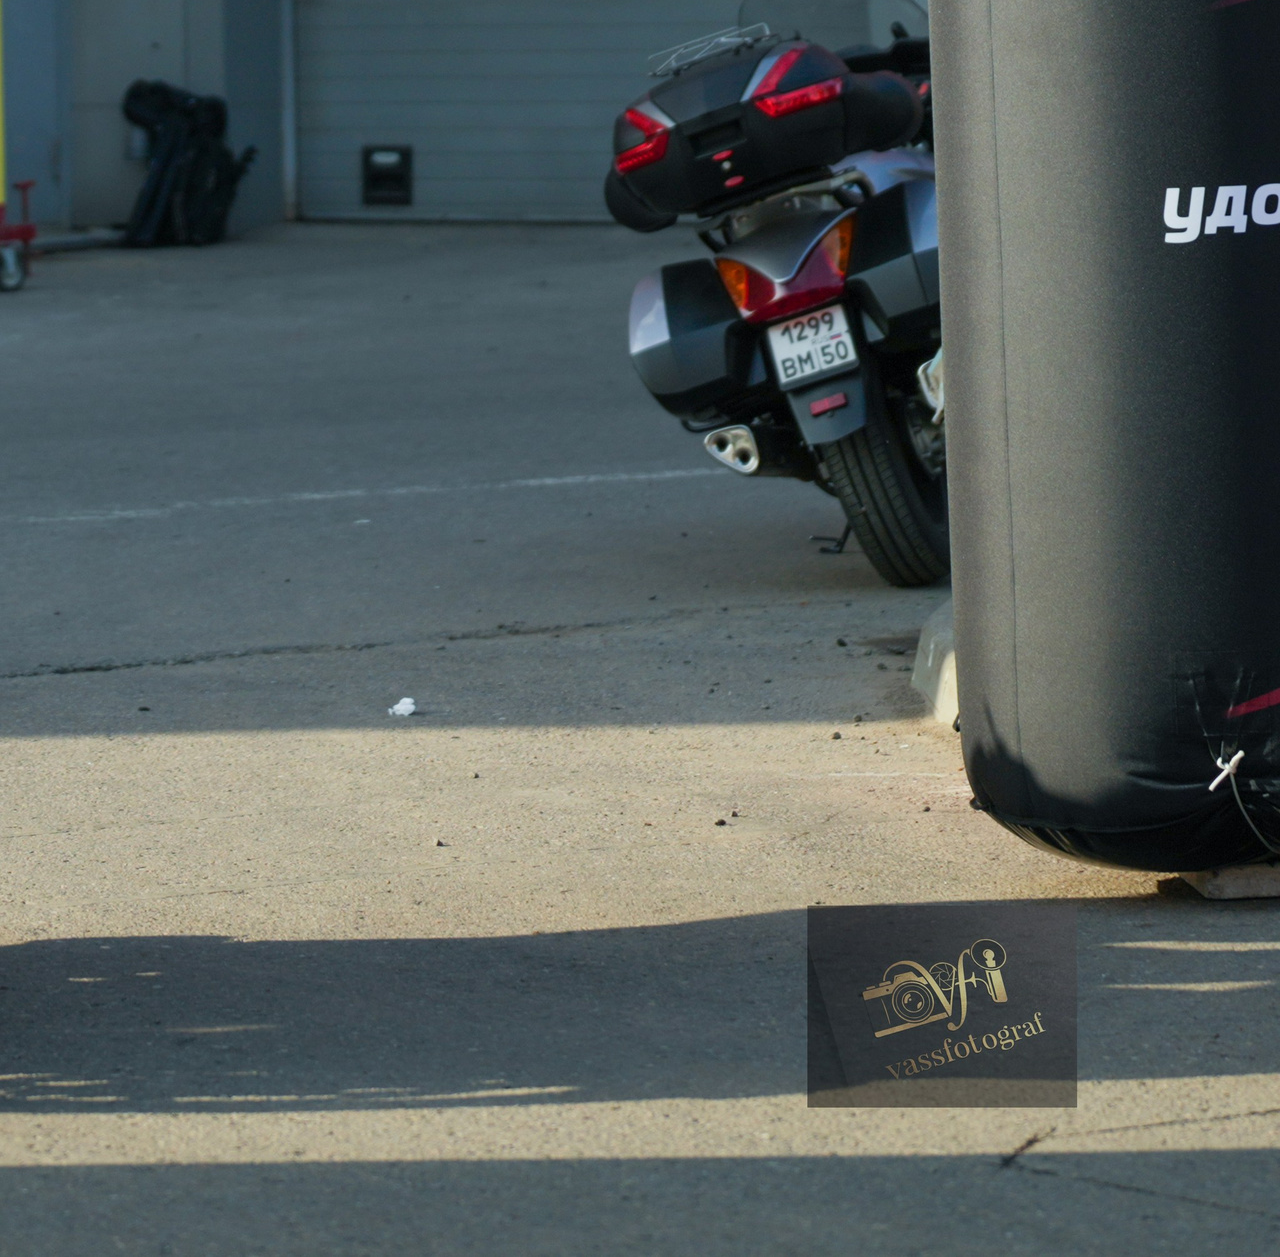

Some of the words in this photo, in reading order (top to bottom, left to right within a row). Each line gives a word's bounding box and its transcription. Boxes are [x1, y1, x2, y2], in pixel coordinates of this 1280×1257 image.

[781, 311, 835, 345] 1299
[781, 350, 815, 379] ВМ
[820, 340, 849, 365] 50
